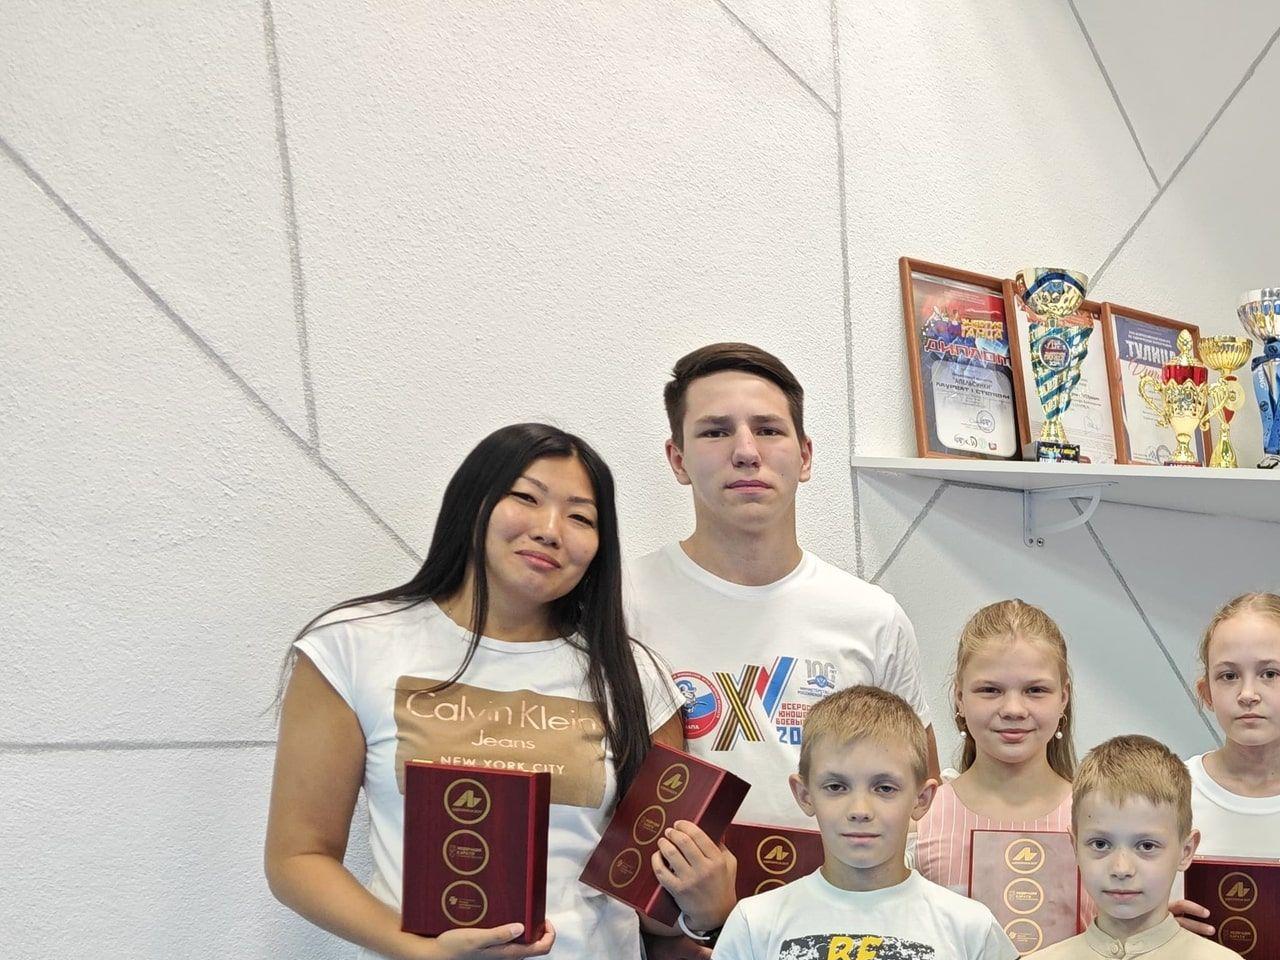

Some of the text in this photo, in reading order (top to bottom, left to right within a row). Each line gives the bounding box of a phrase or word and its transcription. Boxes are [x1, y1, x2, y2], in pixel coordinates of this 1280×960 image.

[407, 690, 598, 732] Calvin Klein
[472, 730, 536, 750] Jeans
[776, 726, 801, 746] 20
[532, 763, 565, 775] CITY
